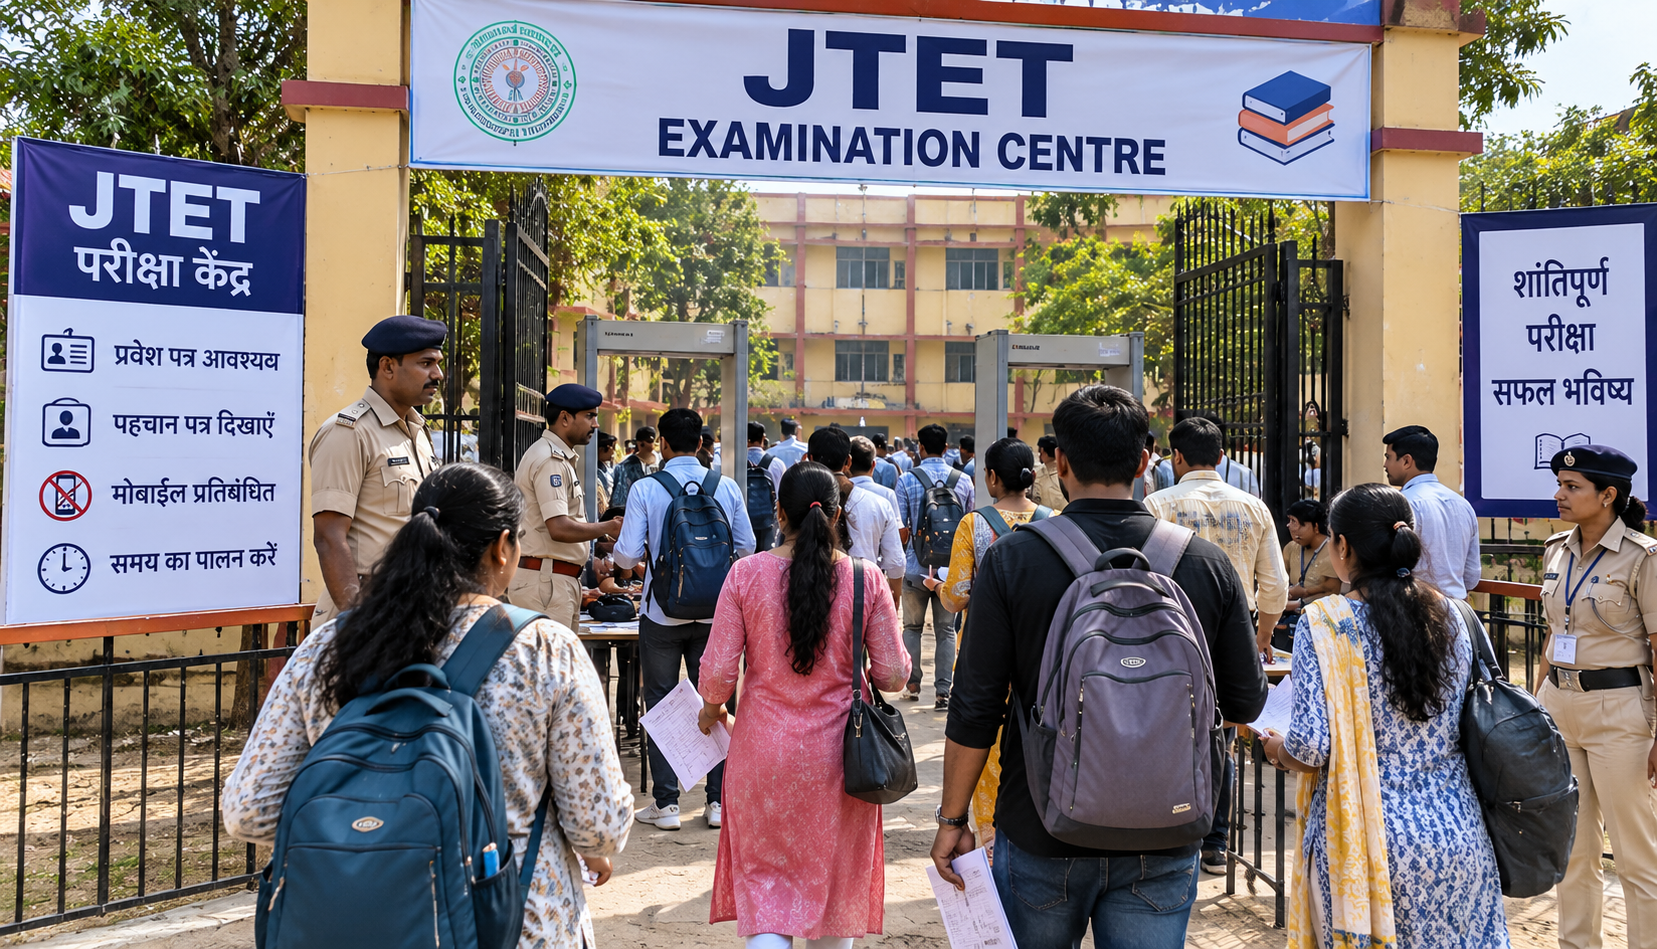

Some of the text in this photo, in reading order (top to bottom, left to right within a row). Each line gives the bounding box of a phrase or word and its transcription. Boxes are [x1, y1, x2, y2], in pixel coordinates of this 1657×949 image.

[743, 28, 1074, 118] JTET
[658, 117, 1166, 176] EXAMINATION CENTRE
[68, 170, 261, 244] JTET
[73, 237, 254, 297] परीक्षा केंद्र
[1513, 256, 1610, 308] शांतिपूर्ण
[113, 338, 164, 367] प्रवेश
[167, 347, 198, 368] पत्र
[1525, 313, 1597, 355] परीक्षा
[1491, 368, 1635, 406] सफल भविष्य
[112, 414, 180, 438] पहचान
[183, 415, 213, 435] पत्र
[110, 477, 188, 508] मोबाईल
[109, 540, 278, 575] समय का पालन करें
